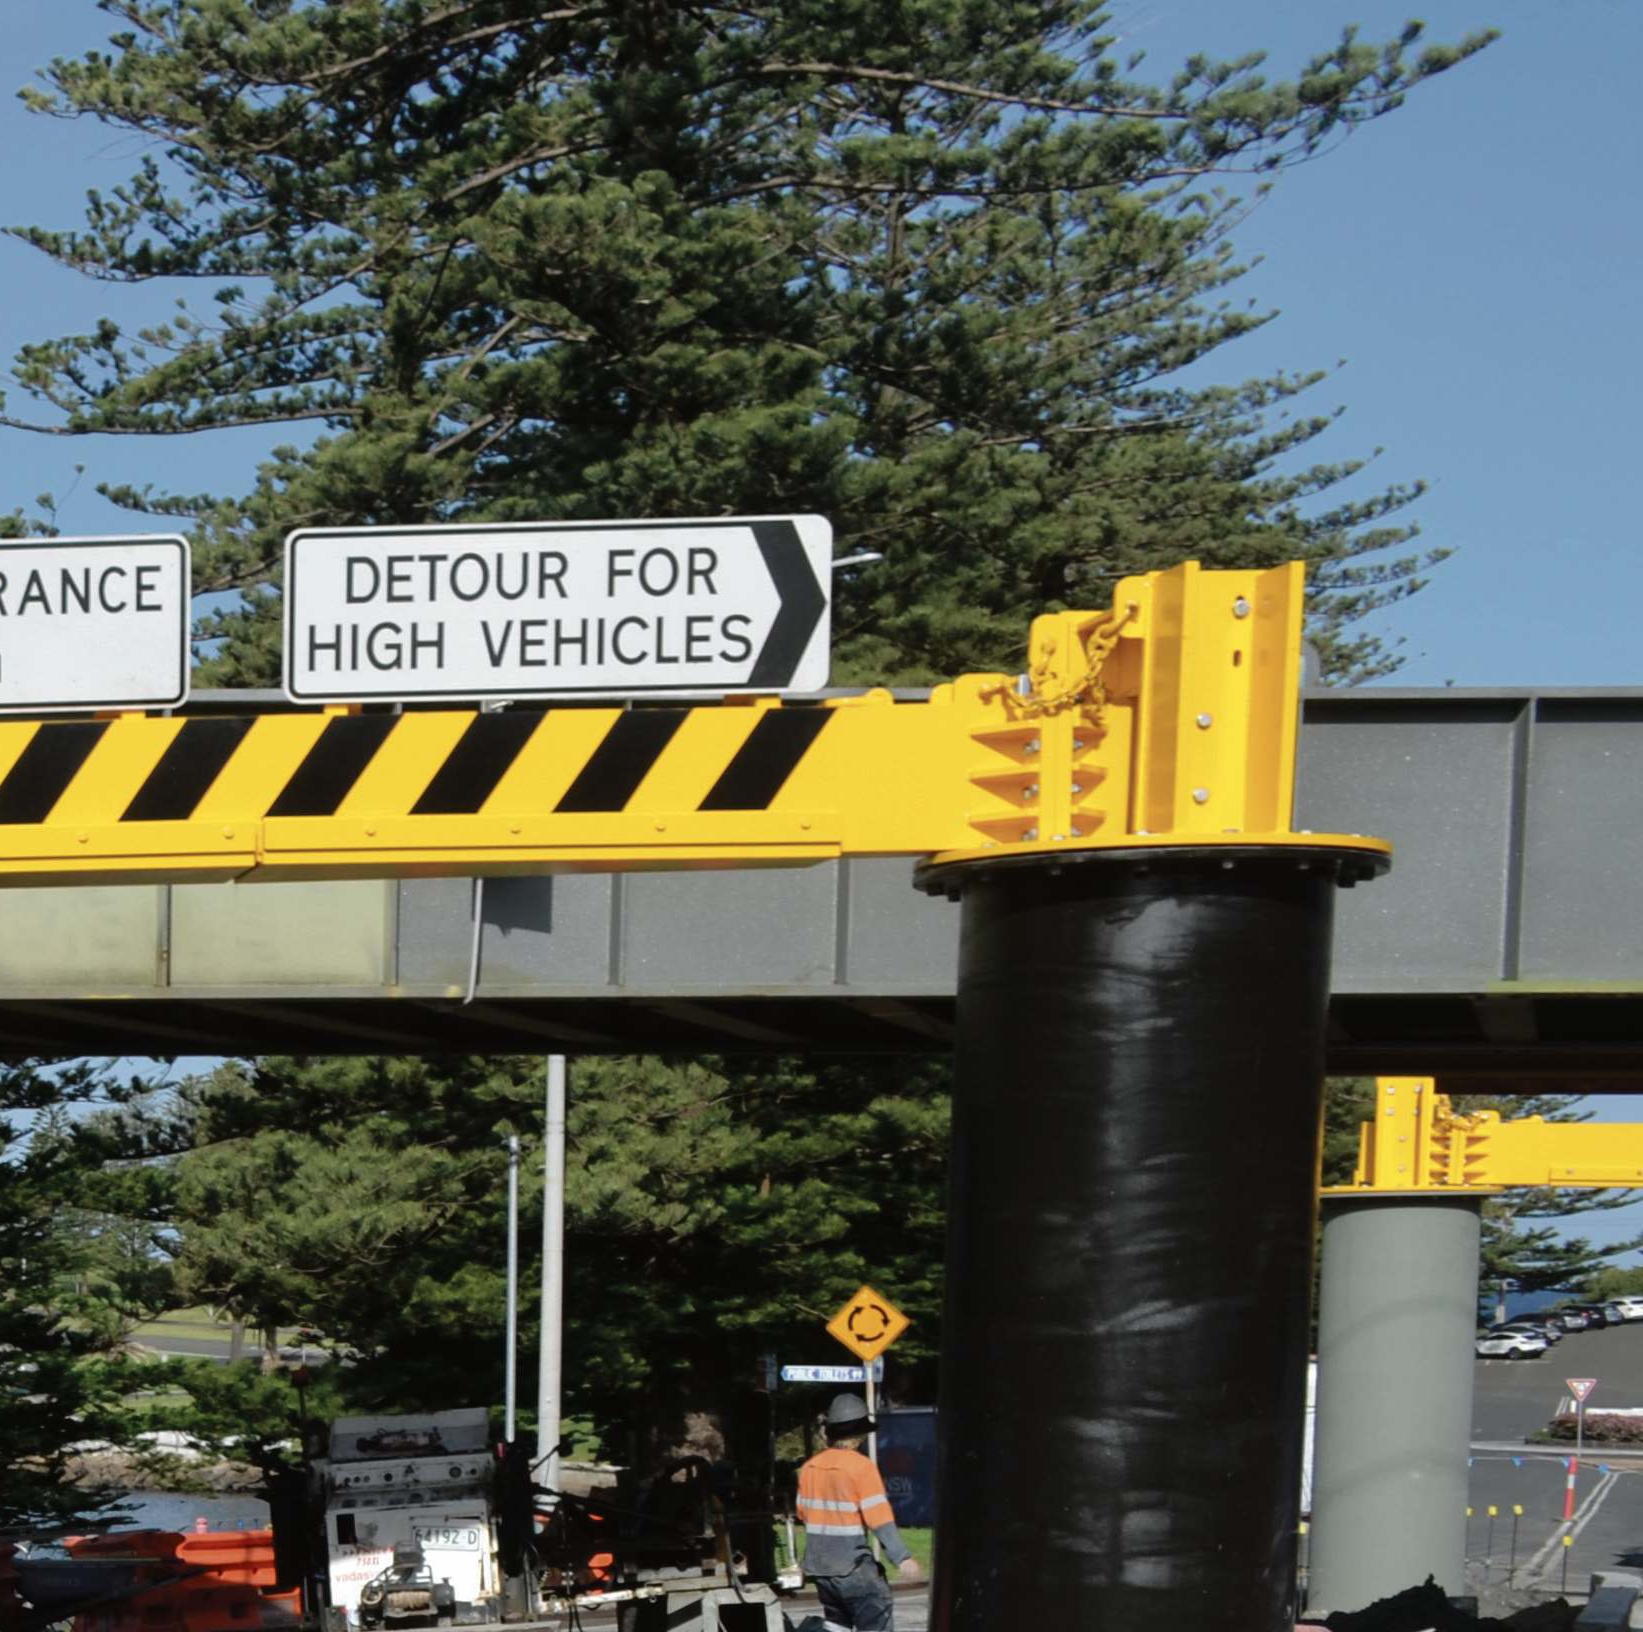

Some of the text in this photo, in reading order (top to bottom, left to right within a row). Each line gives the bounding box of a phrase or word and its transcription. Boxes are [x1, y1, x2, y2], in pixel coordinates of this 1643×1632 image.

[346, 546, 719, 604] DETOUR FOR
[307, 613, 753, 672] HIGH VEHICLES
